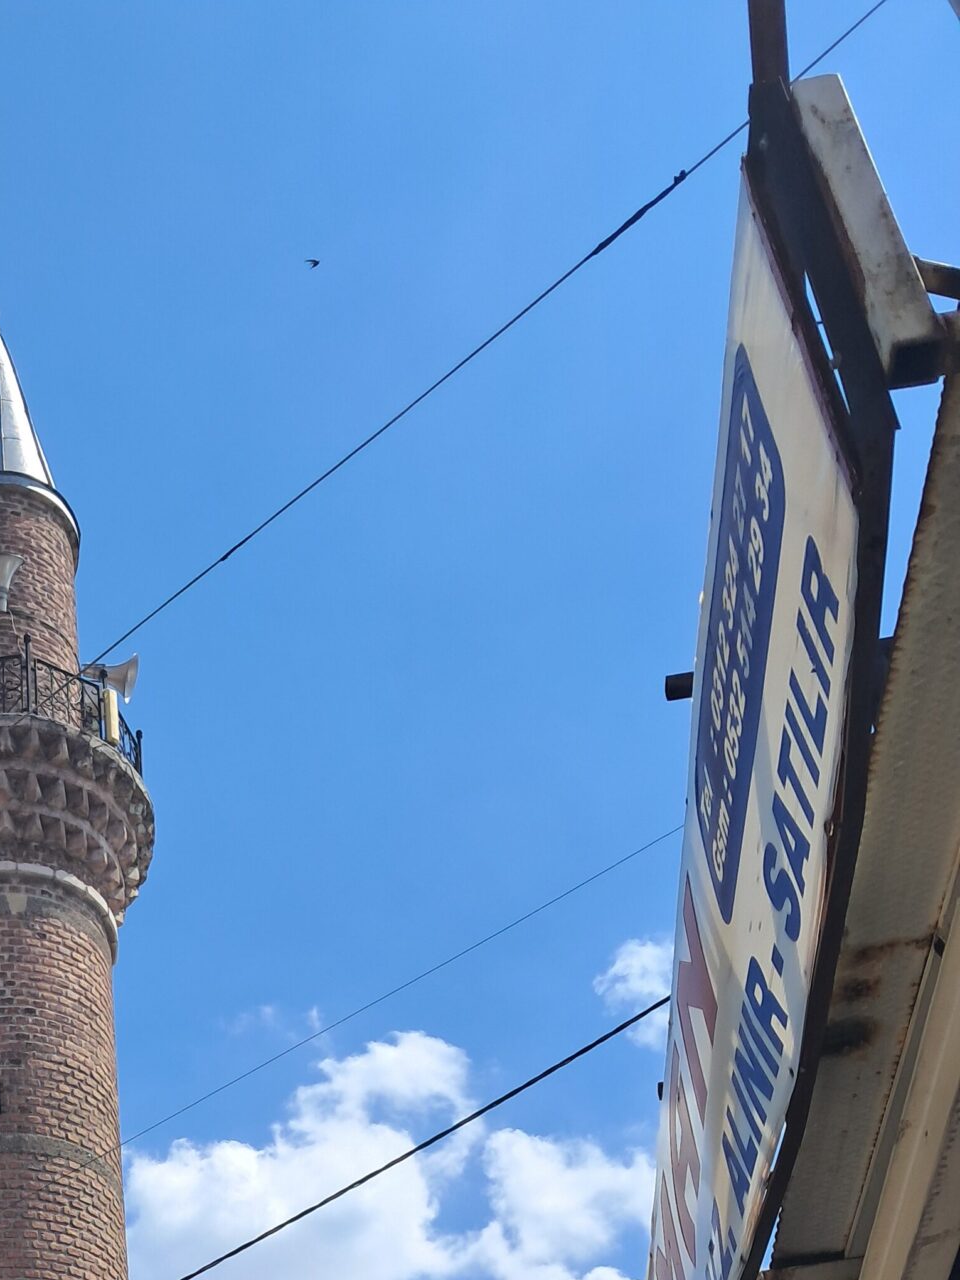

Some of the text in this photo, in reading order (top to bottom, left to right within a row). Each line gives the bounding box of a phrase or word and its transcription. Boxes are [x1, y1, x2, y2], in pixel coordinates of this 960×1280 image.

[755, 440, 773, 522] 34
[747, 515, 764, 596] 29
[701, 766, 713, 831] Tel
[722, 534, 739, 631] 324
[732, 462, 747, 544] 27
[740, 392, 755, 467] 17
[737, 581, 757, 678] 514
[724, 669, 746, 780] 0532
[712, 799, 730, 883] Gsm
[722, 956, 789, 1218] ALINIR
[762, 535, 840, 942] SATILIR
